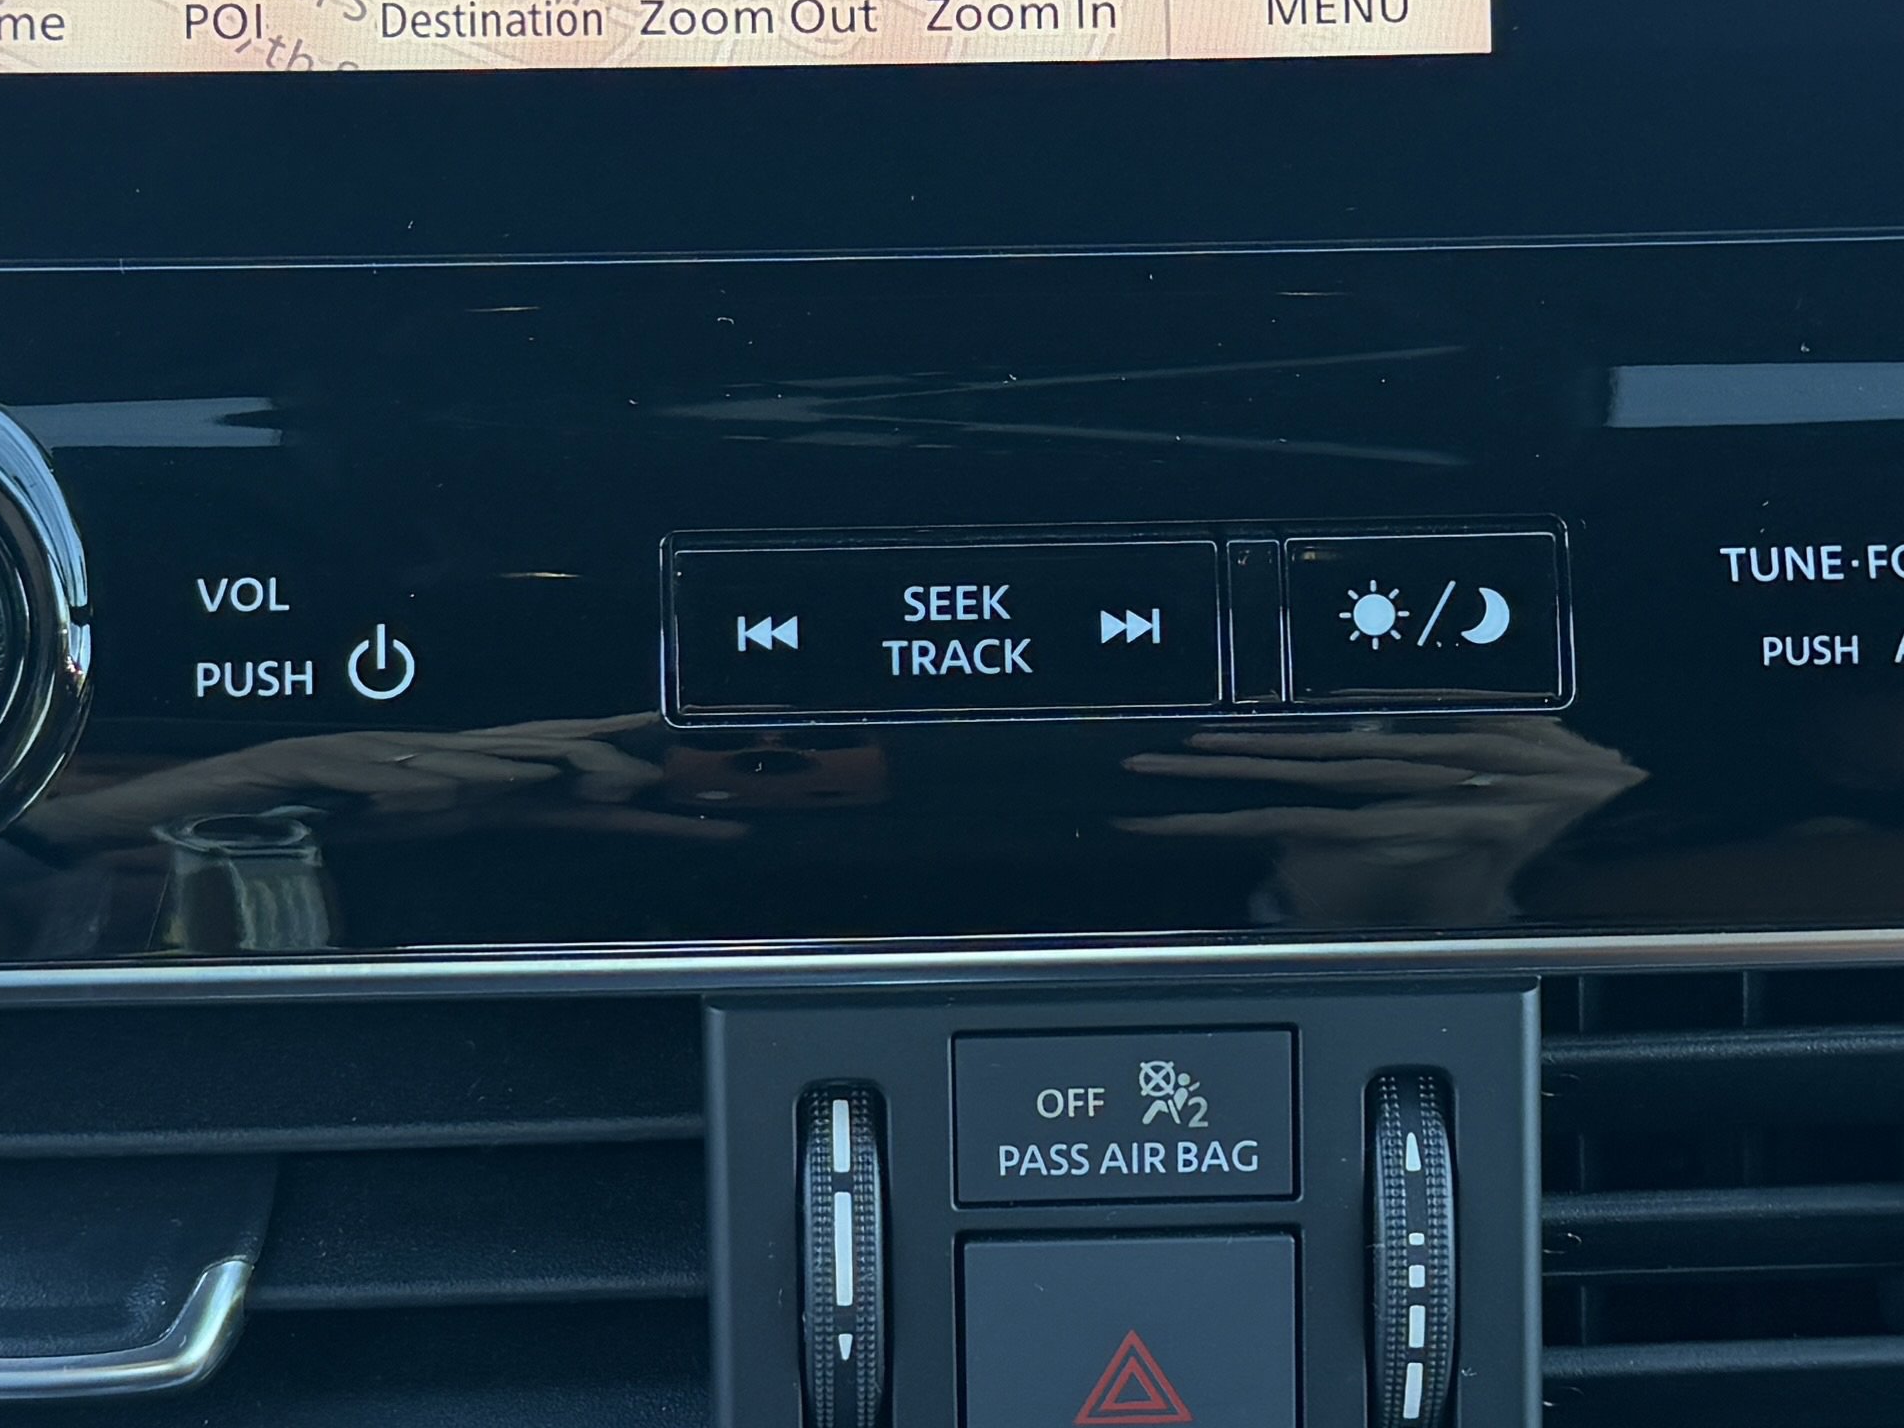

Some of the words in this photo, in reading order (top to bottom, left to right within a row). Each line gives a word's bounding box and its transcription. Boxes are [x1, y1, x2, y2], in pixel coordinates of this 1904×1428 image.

[184, 3, 263, 40] POI
[380, 1, 604, 39] Destination
[196, 576, 290, 613] VOL
[902, 582, 1012, 624] SEEK
[881, 636, 1034, 677] TRACK
[1761, 634, 1860, 668] PUSH
[195, 659, 315, 699] PUSH
[1034, 1086, 1107, 1121] OFF
[996, 1142, 1092, 1178] PASS
[1098, 1140, 1169, 1176] AIR
[1175, 1137, 1261, 1174] BAG
